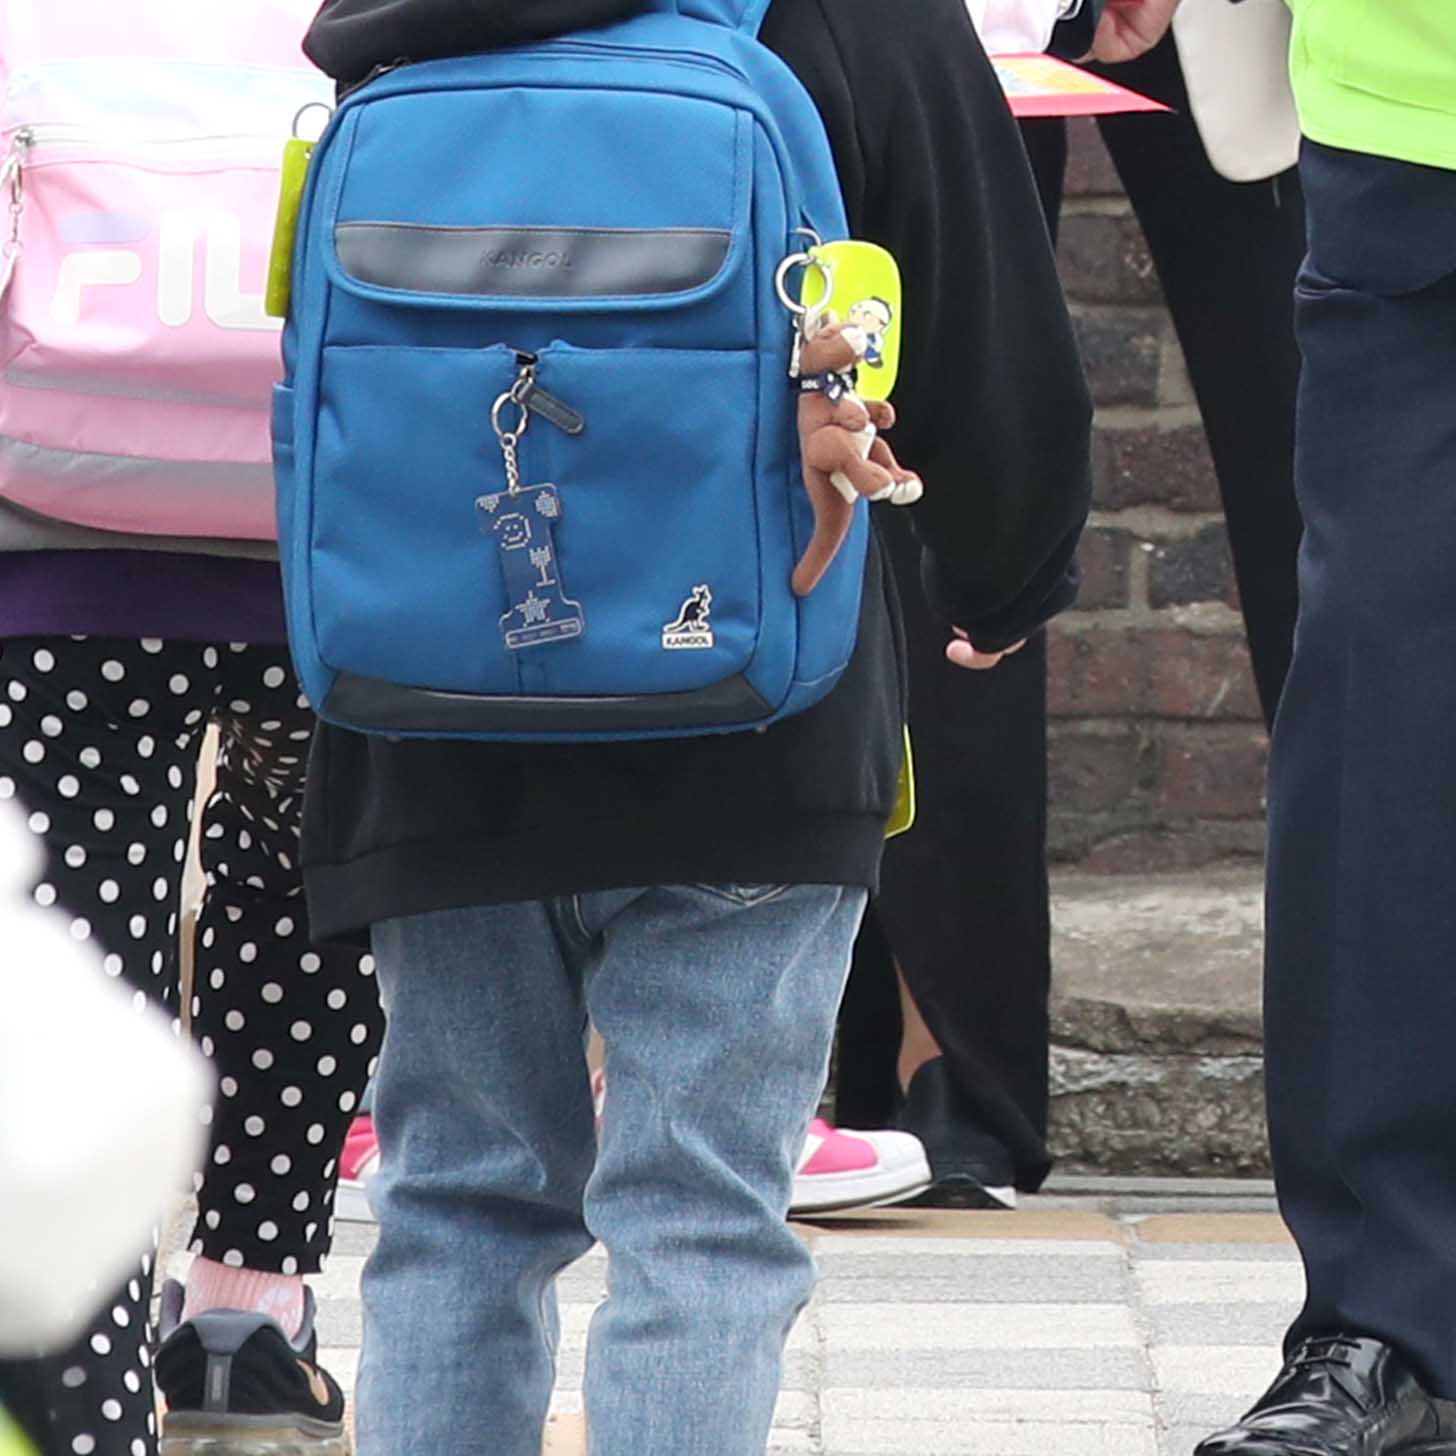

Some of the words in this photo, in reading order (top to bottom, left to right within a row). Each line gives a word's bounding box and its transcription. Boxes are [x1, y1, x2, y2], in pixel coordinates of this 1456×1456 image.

[480, 248, 575, 270] KANGOL
[50, 211, 286, 331] FIL
[666, 635, 710, 647] KANGOL
